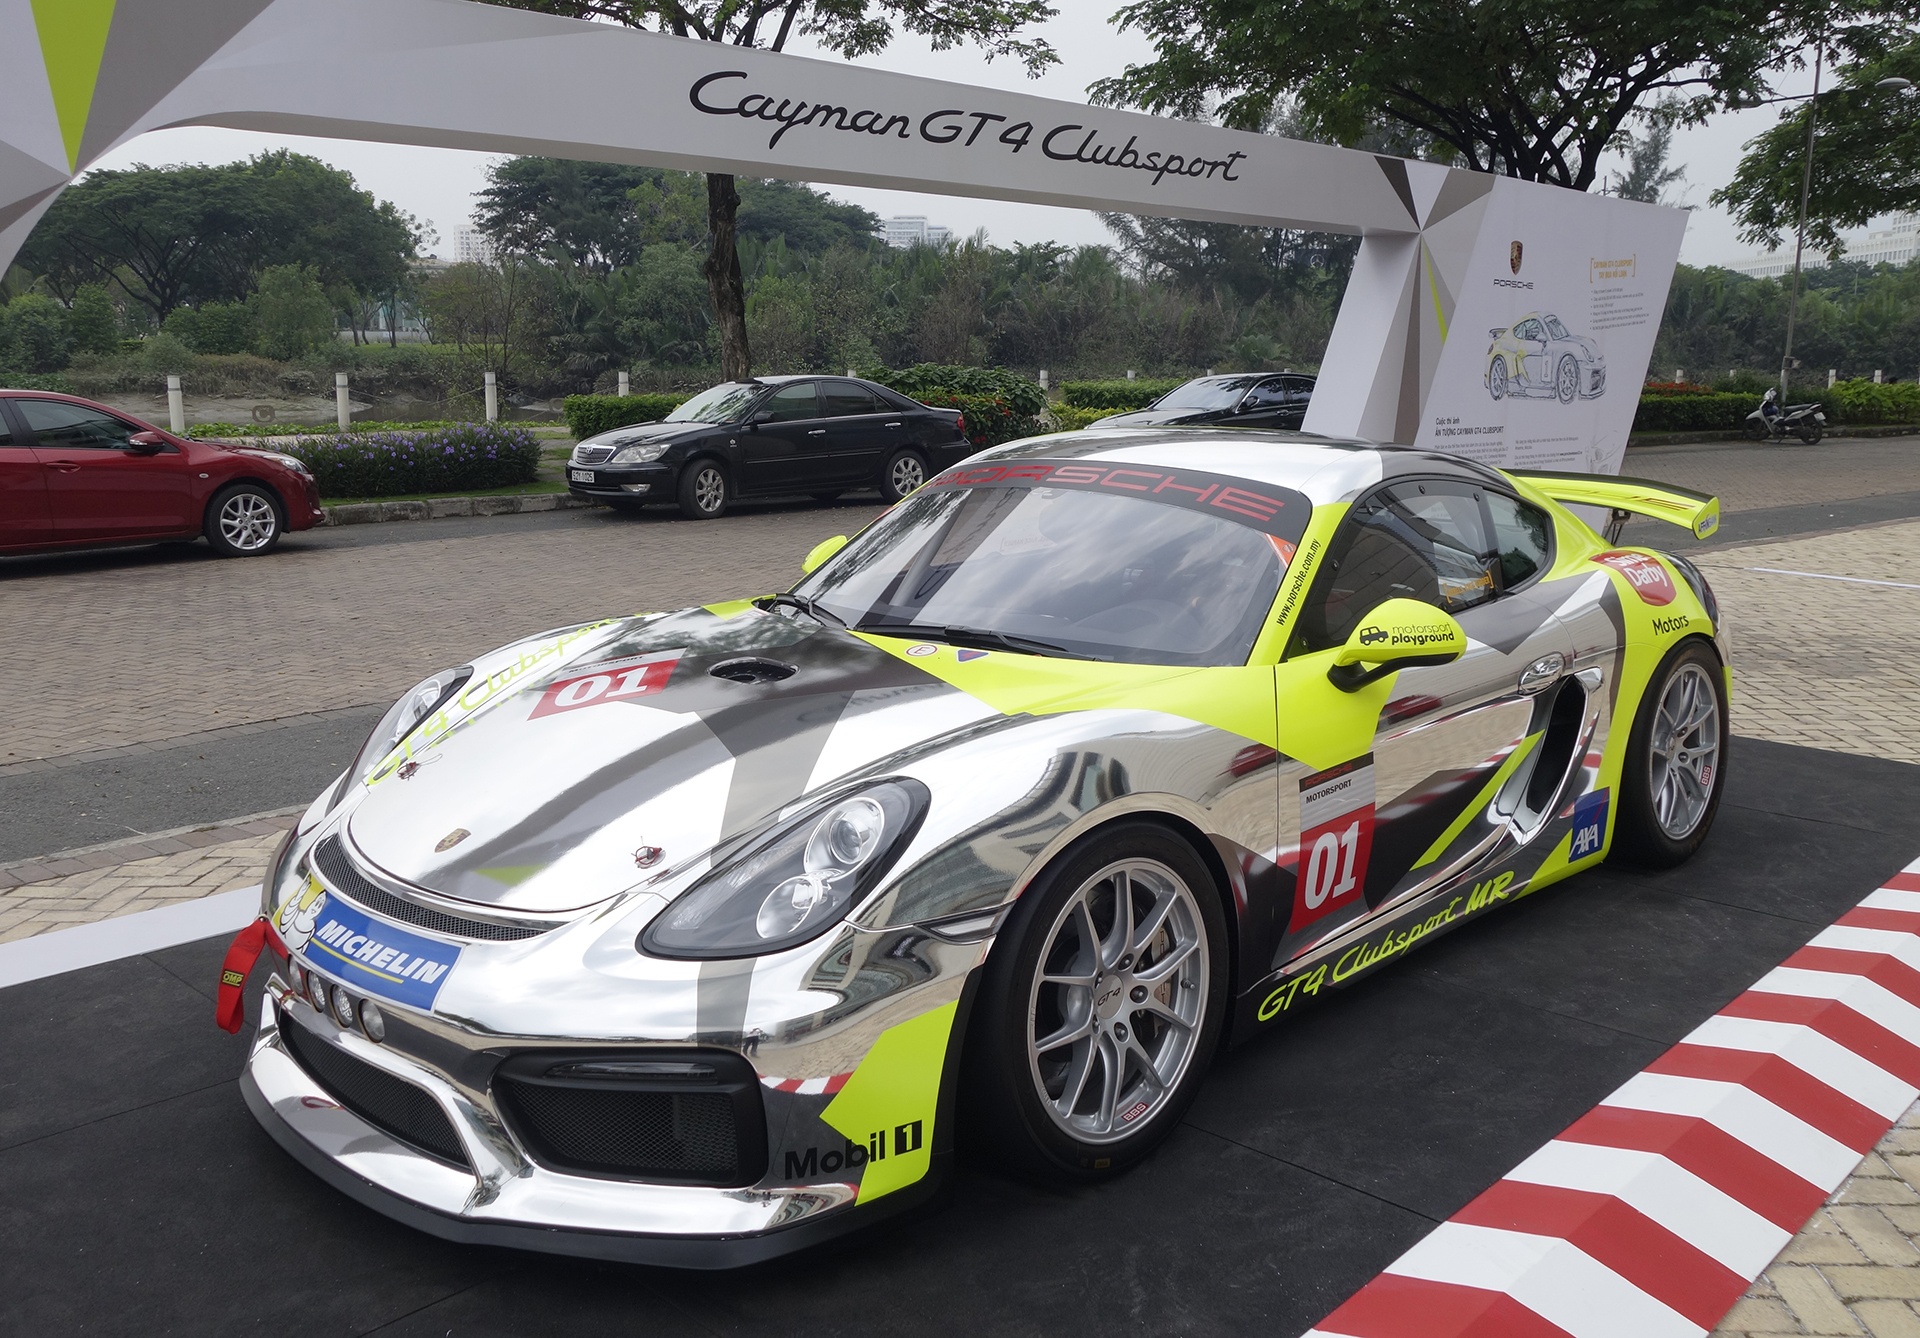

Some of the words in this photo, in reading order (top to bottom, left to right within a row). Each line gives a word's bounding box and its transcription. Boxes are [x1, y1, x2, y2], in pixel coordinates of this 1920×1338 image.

[689, 71, 910, 149] Cayman
[919, 109, 1033, 154] GT4
[1041, 124, 1247, 186] Clubsport
[1493, 278, 1534, 290] PORSCHE
[1456, 427, 1473, 436] CAYMAN
[1482, 426, 1504, 435] CLUBSPORT
[919, 465, 1284, 522] PORSCHE
[1276, 538, 1322, 626] www.porsche.com.my
[1624, 563, 1668, 587] Darby
[1391, 631, 1455, 645] playground
[1392, 622, 1452, 636] motorsport
[1652, 615, 1689, 636] Motors
[554, 666, 649, 707] 01
[1305, 778, 1353, 804] MOTORSPORT
[1569, 823, 1599, 857] AXA
[1304, 820, 1360, 910] 01
[316, 919, 449, 984] MICHELIN
[1257, 964, 1328, 1022] GT4
[1332, 896, 1463, 983] Clubsport
[1464, 870, 1515, 916] MR
[223, 973, 243, 985] OMP
[1097, 987, 1121, 1006] GT4
[1123, 1103, 1147, 1121] BBS
[784, 1129, 886, 1180] Mobil
